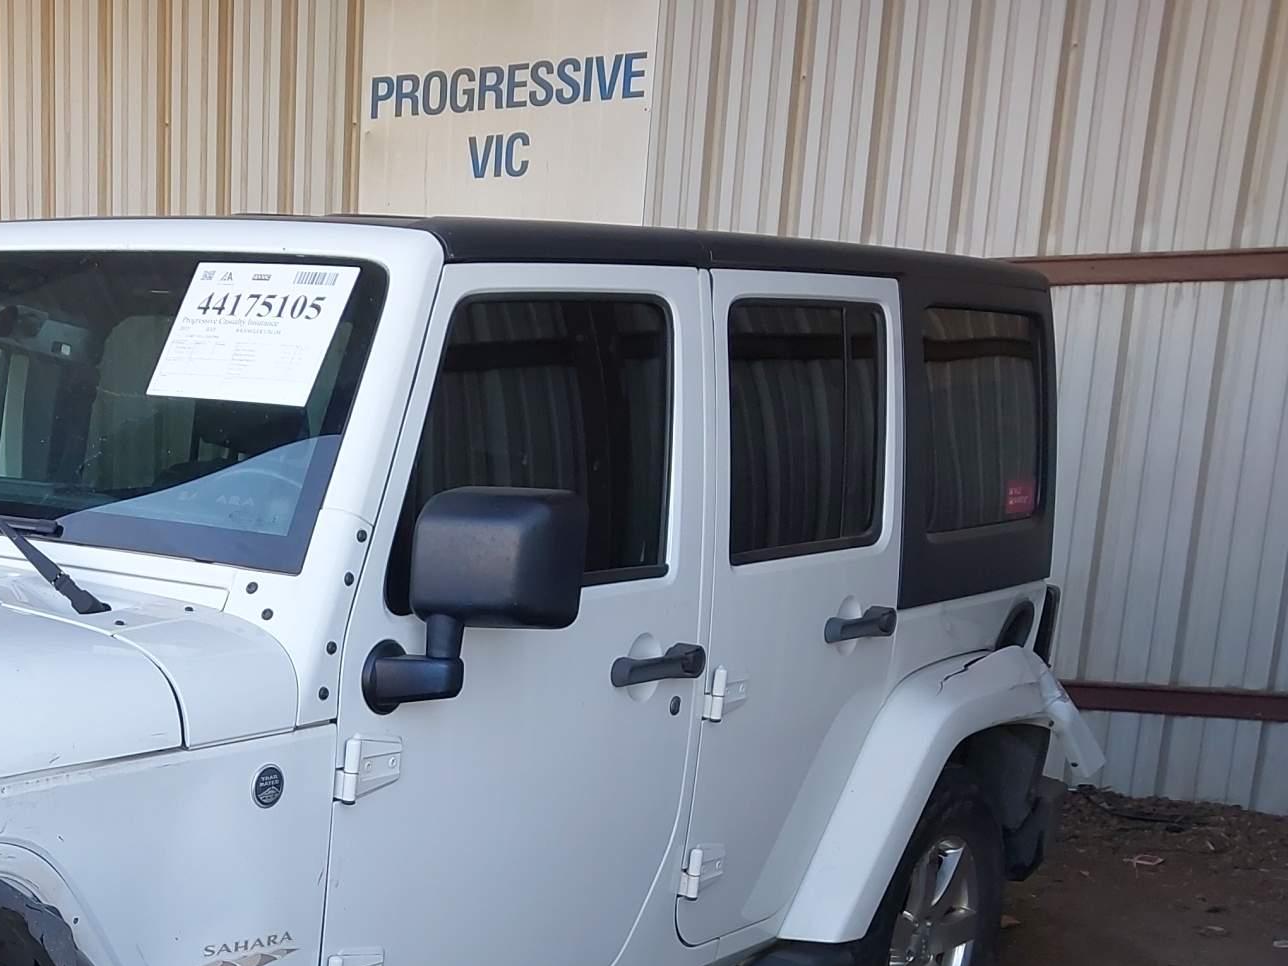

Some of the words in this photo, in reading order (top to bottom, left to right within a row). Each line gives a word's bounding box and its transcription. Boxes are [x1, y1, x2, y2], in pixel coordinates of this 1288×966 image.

[370, 51, 649, 120] PROGRESSIVE
[468, 131, 530, 179] VIC
[197, 292, 327, 320] 44175105
[203, 930, 294, 957] SAHARA
